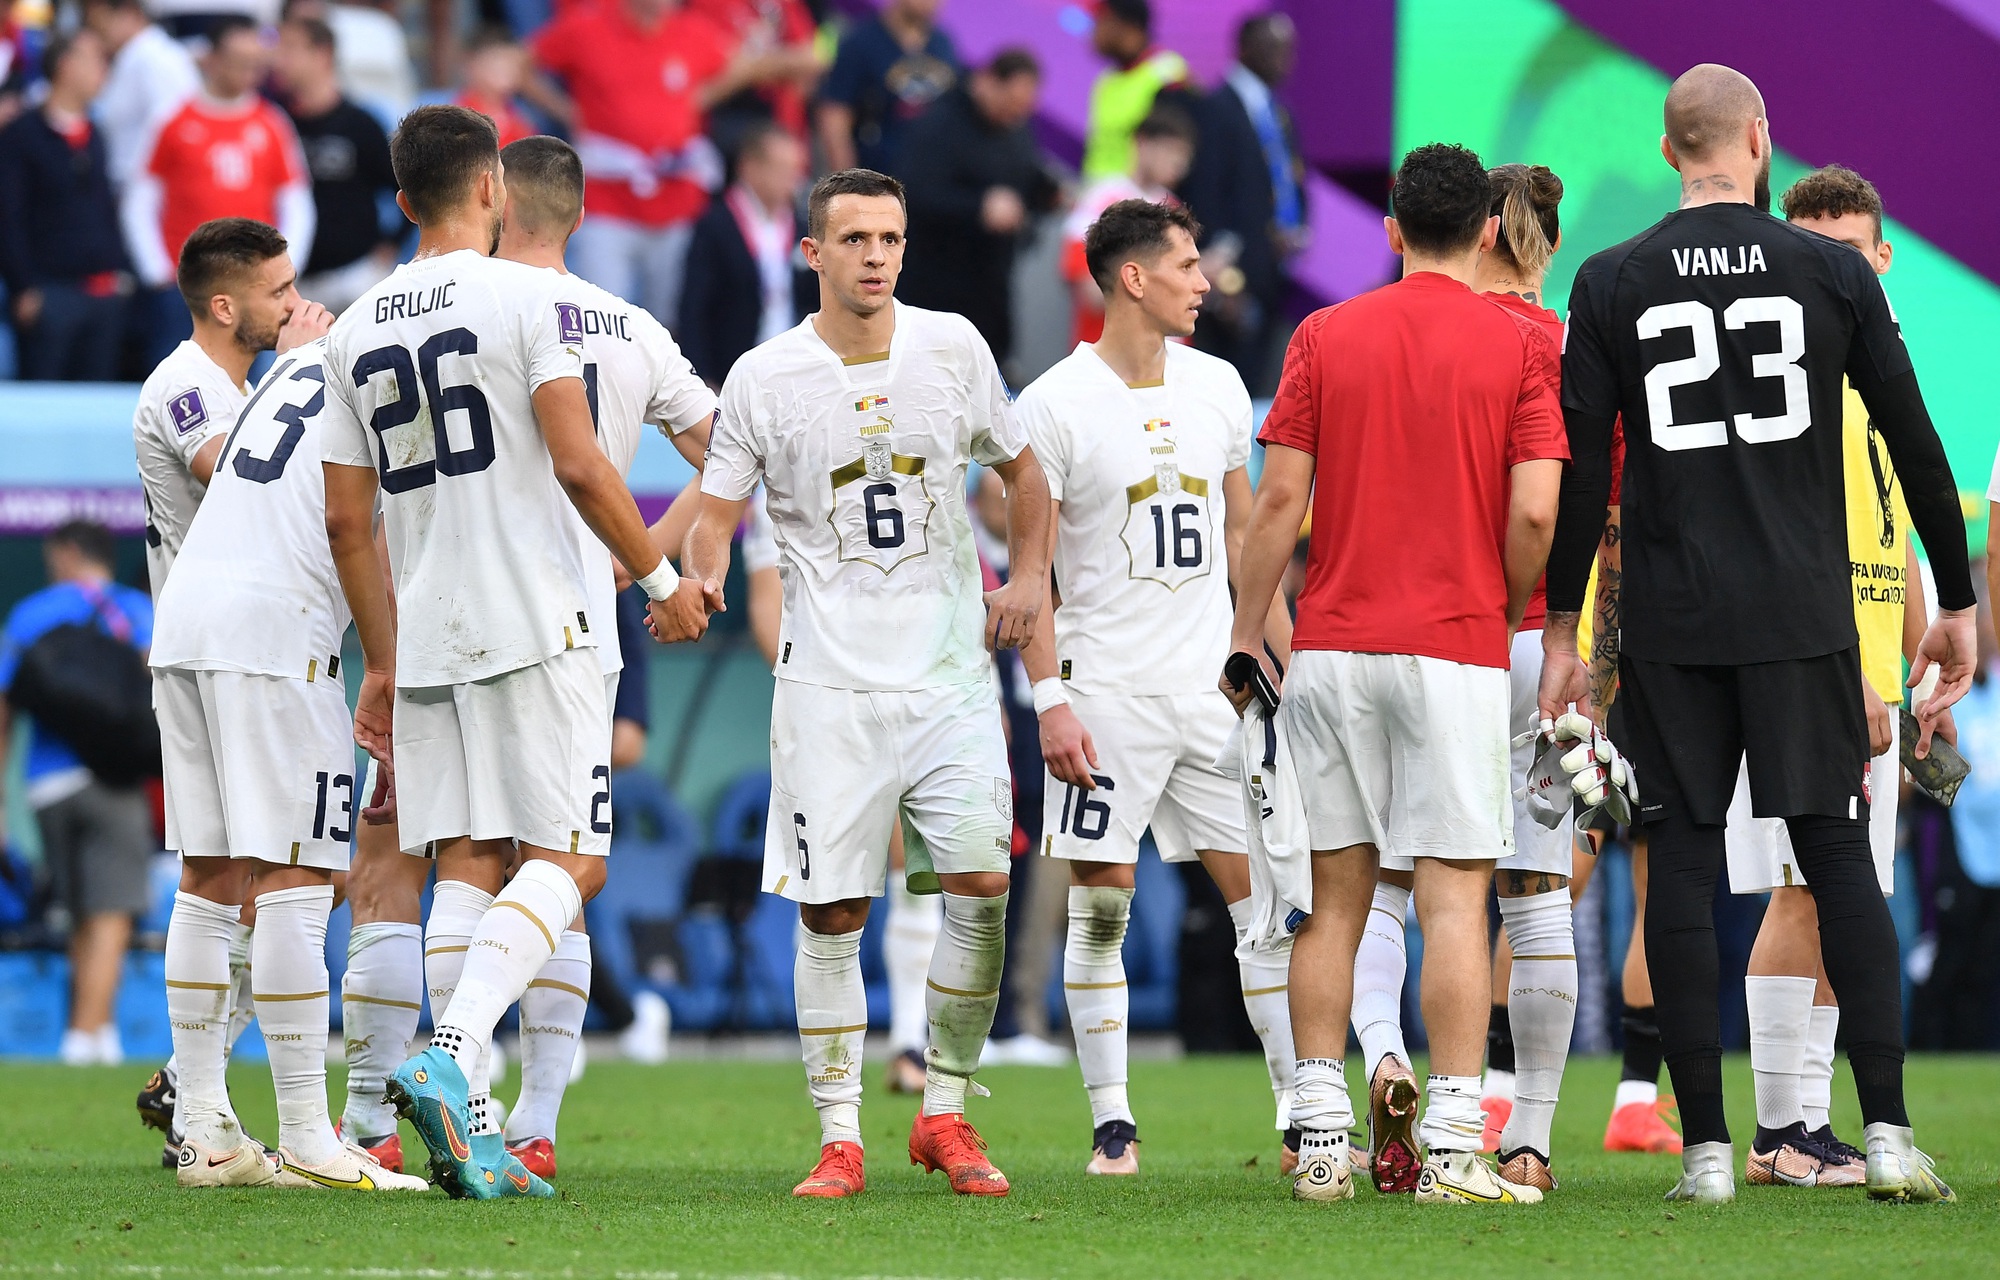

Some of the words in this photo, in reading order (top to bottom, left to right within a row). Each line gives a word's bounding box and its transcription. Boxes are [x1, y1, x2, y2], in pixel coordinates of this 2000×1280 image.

[1671, 244, 1767, 276] VANJA
[375, 279, 456, 324] GRUJIĆ
[584, 310, 632, 342] OVIĆ
[1636, 296, 1812, 451] 23
[216, 358, 326, 484] 13
[352, 327, 496, 495] 26
[860, 424, 890, 436] PUMA
[1150, 445, 1174, 455] PUMA
[863, 483, 905, 548] 6
[1150, 503, 1202, 568] 16
[312, 771, 352, 843] 13
[1059, 774, 1115, 840] 16
[794, 812, 810, 880] 6
[1086, 1025, 1119, 1034] PUMA
[811, 1073, 845, 1082] PUMA
